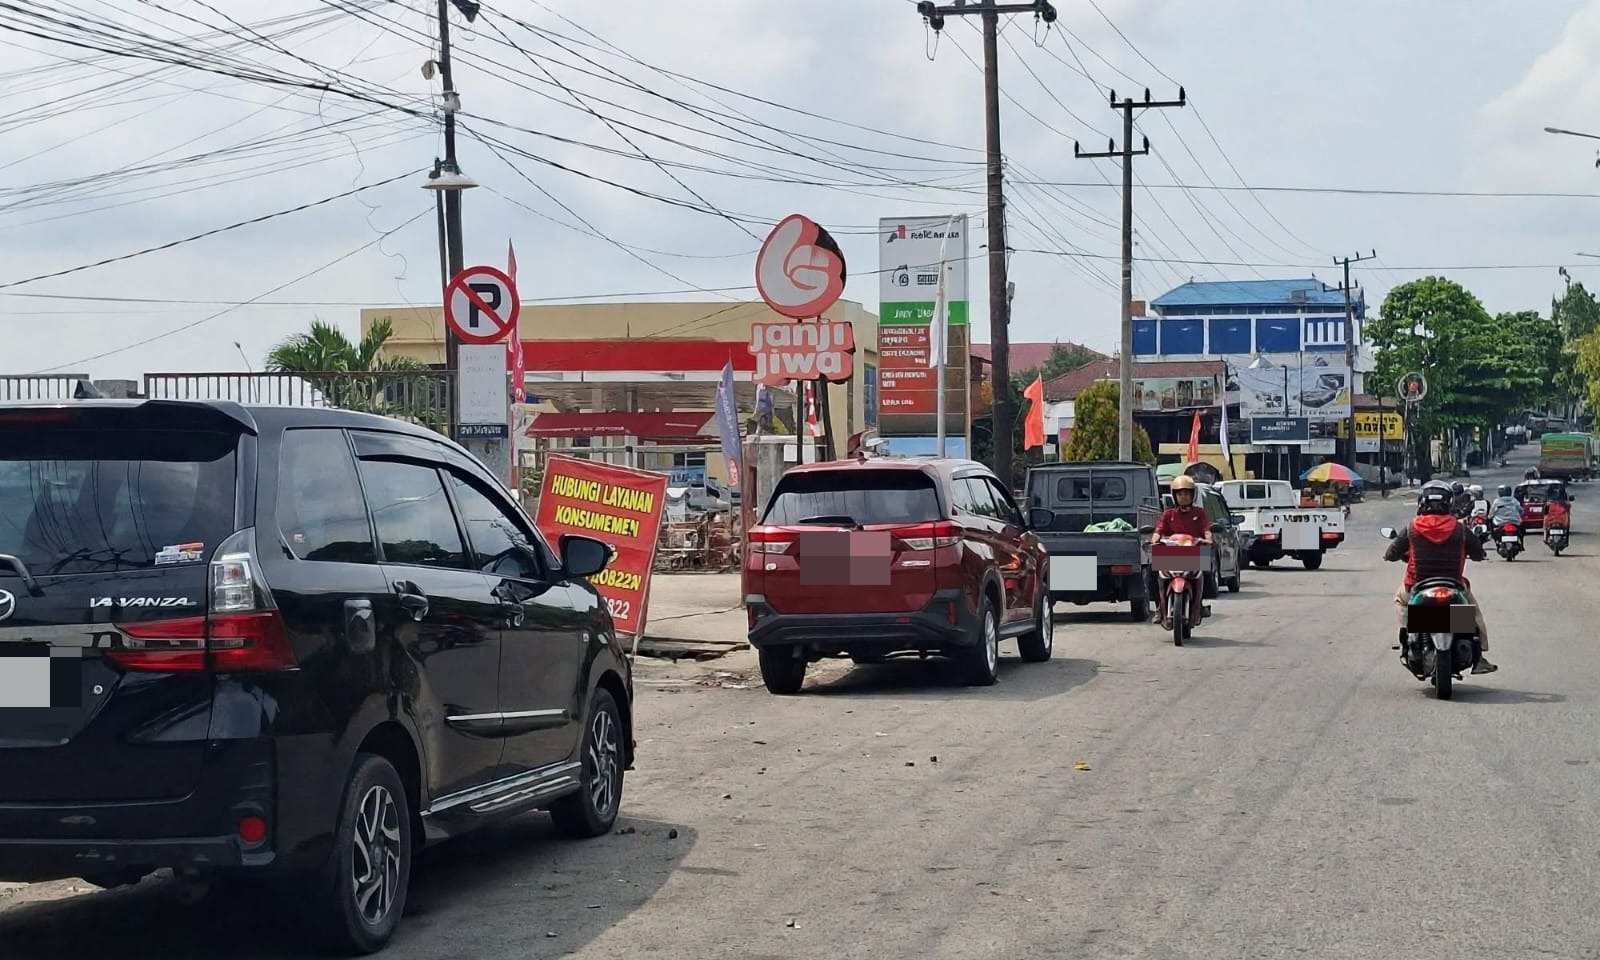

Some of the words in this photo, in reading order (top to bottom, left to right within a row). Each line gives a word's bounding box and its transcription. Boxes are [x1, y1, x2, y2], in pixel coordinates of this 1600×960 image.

[752, 349, 841, 380] jiwa
[552, 475, 601, 503] HUBUNGI
[602, 484, 655, 513] LAYANAN
